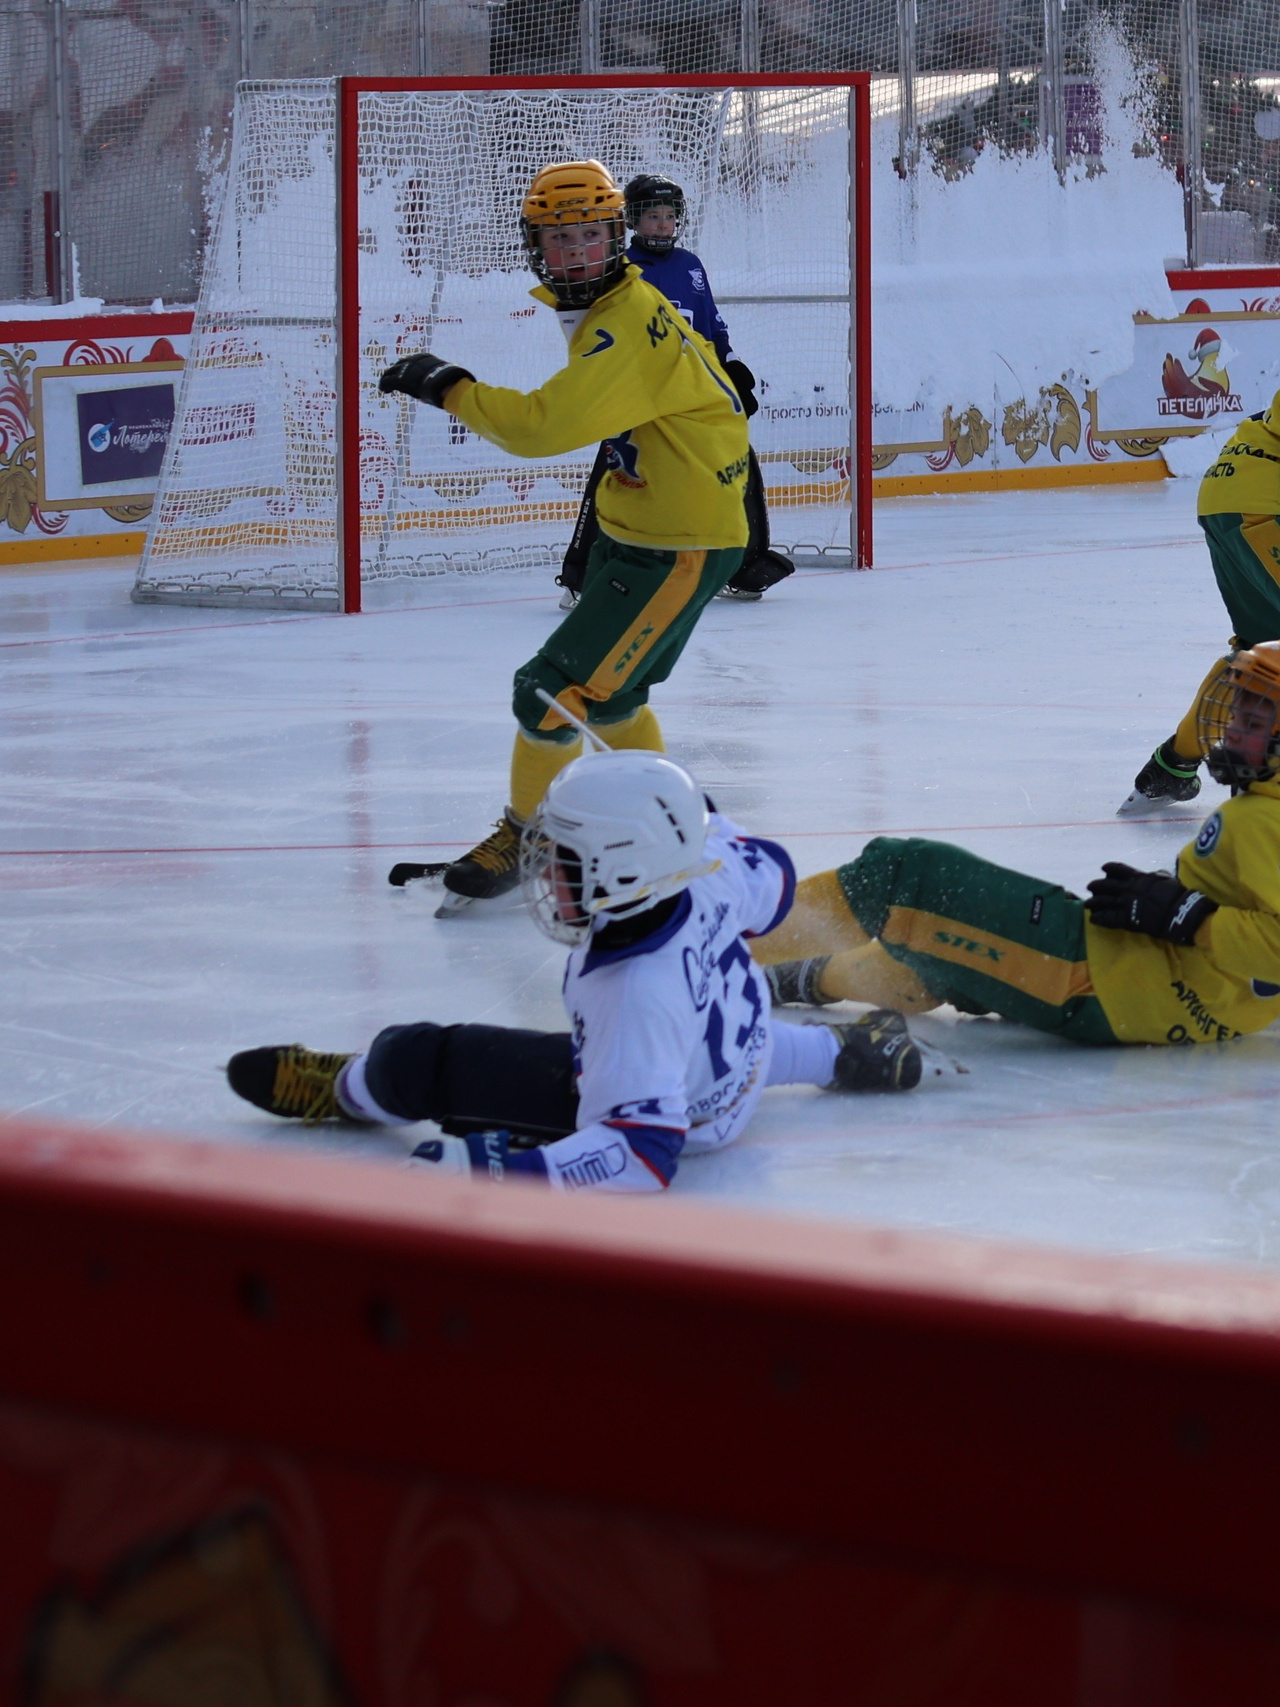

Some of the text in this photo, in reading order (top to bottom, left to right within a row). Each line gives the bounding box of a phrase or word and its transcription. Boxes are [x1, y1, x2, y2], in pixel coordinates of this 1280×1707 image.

[1158, 395, 1242, 414] ПЕТЕЛИНКА
[613, 621, 655, 674] STEX
[934, 930, 1006, 962] STEX
